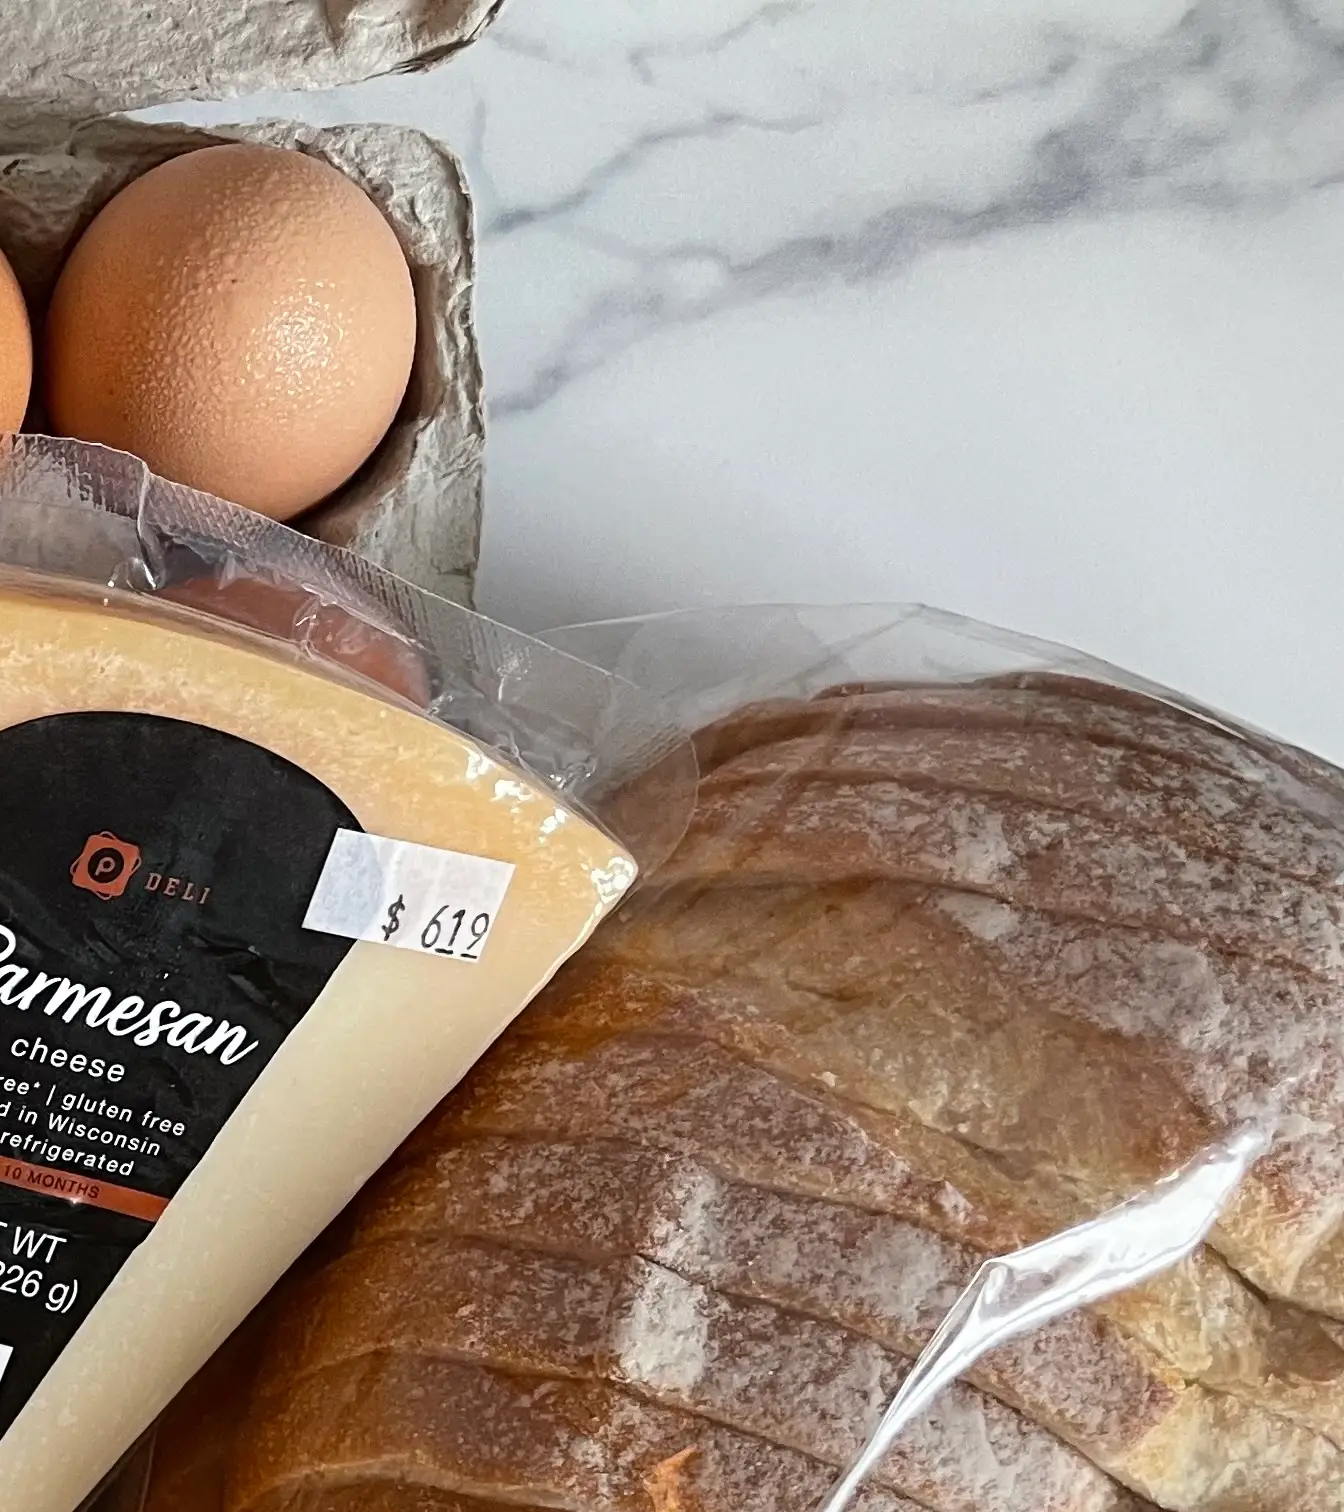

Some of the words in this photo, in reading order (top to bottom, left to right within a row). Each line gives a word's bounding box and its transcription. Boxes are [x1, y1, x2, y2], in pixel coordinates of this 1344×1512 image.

[144, 871, 210, 905] DELI
[10, 1036, 127, 1084] cheese
[17, 1104, 39, 1126] in
[48, 1112, 162, 1157] Wisconsin
[61, 1089, 133, 1123] gluten
[141, 1110, 187, 1138] free
[0, 1131, 136, 1177] refrigerated
[2, 1162, 23, 1180] 10
[26, 1169, 102, 1200] MONTHS
[12, 1225, 69, 1265] WT
[44, 1278, 79, 1314] g)
